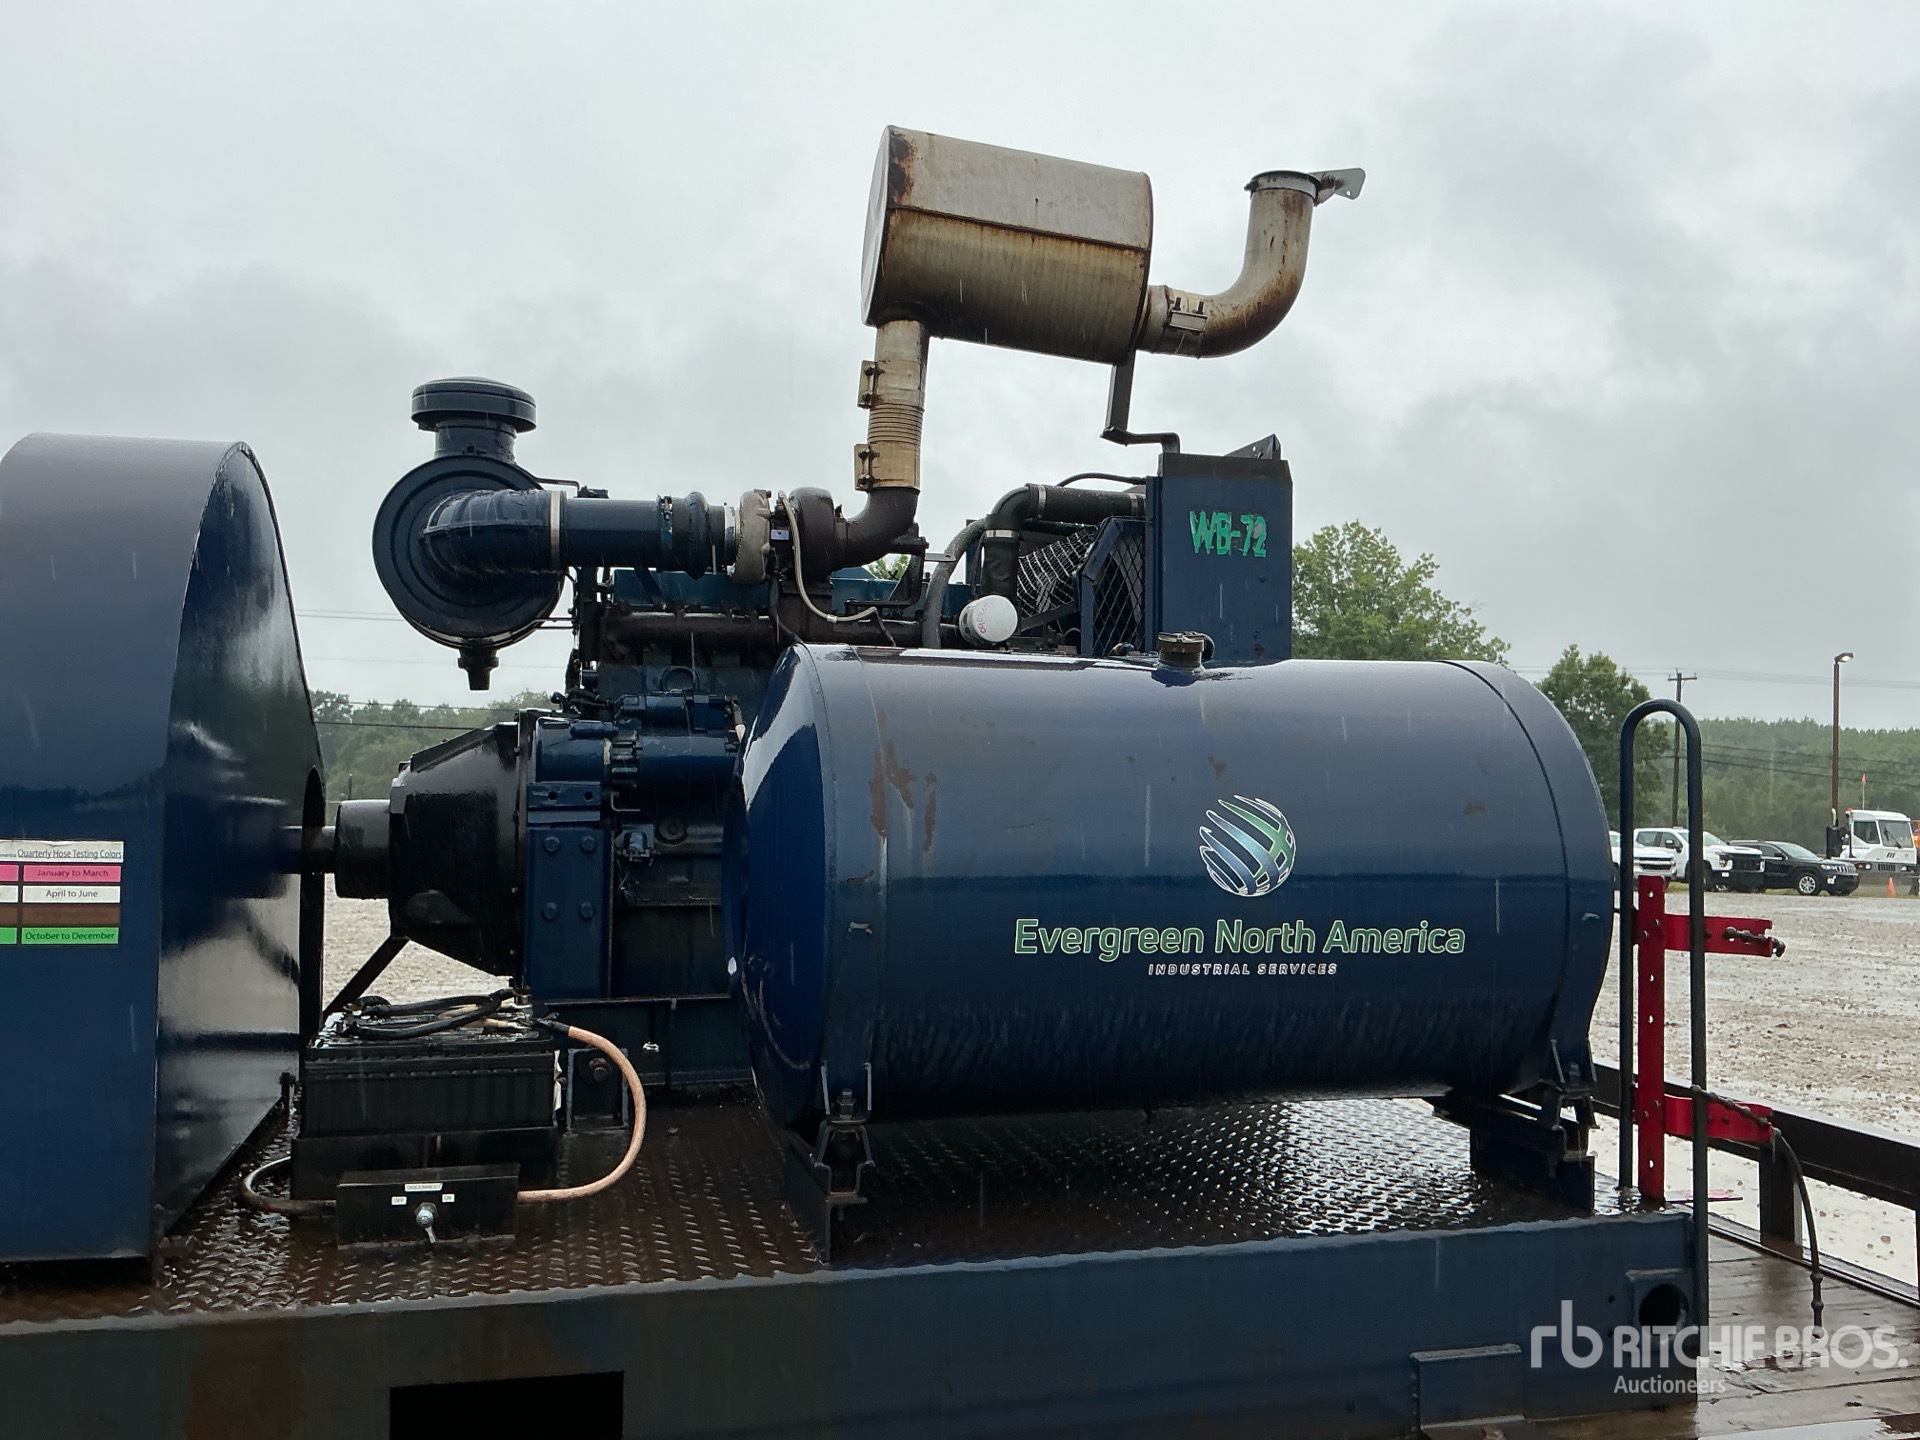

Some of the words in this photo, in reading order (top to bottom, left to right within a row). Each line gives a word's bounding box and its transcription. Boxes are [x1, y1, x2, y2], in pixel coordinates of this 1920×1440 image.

[1189, 510, 1267, 557] WB-72
[17, 849, 51, 859] Quarterly
[53, 849, 71, 858] Hose
[73, 849, 98, 859] Testing
[100, 849, 122, 858] Colors
[37, 869, 70, 877] January
[82, 869, 109, 877] March
[45, 890, 66, 898] April
[25, 931, 59, 940] October
[72, 931, 115, 940] December
[1014, 918, 1205, 962] Evergreen
[1214, 919, 1316, 954] North
[1322, 919, 1466, 954] America
[1148, 963, 1250, 975] INDUSTRIAL
[1257, 963, 1338, 975] SERVICES
